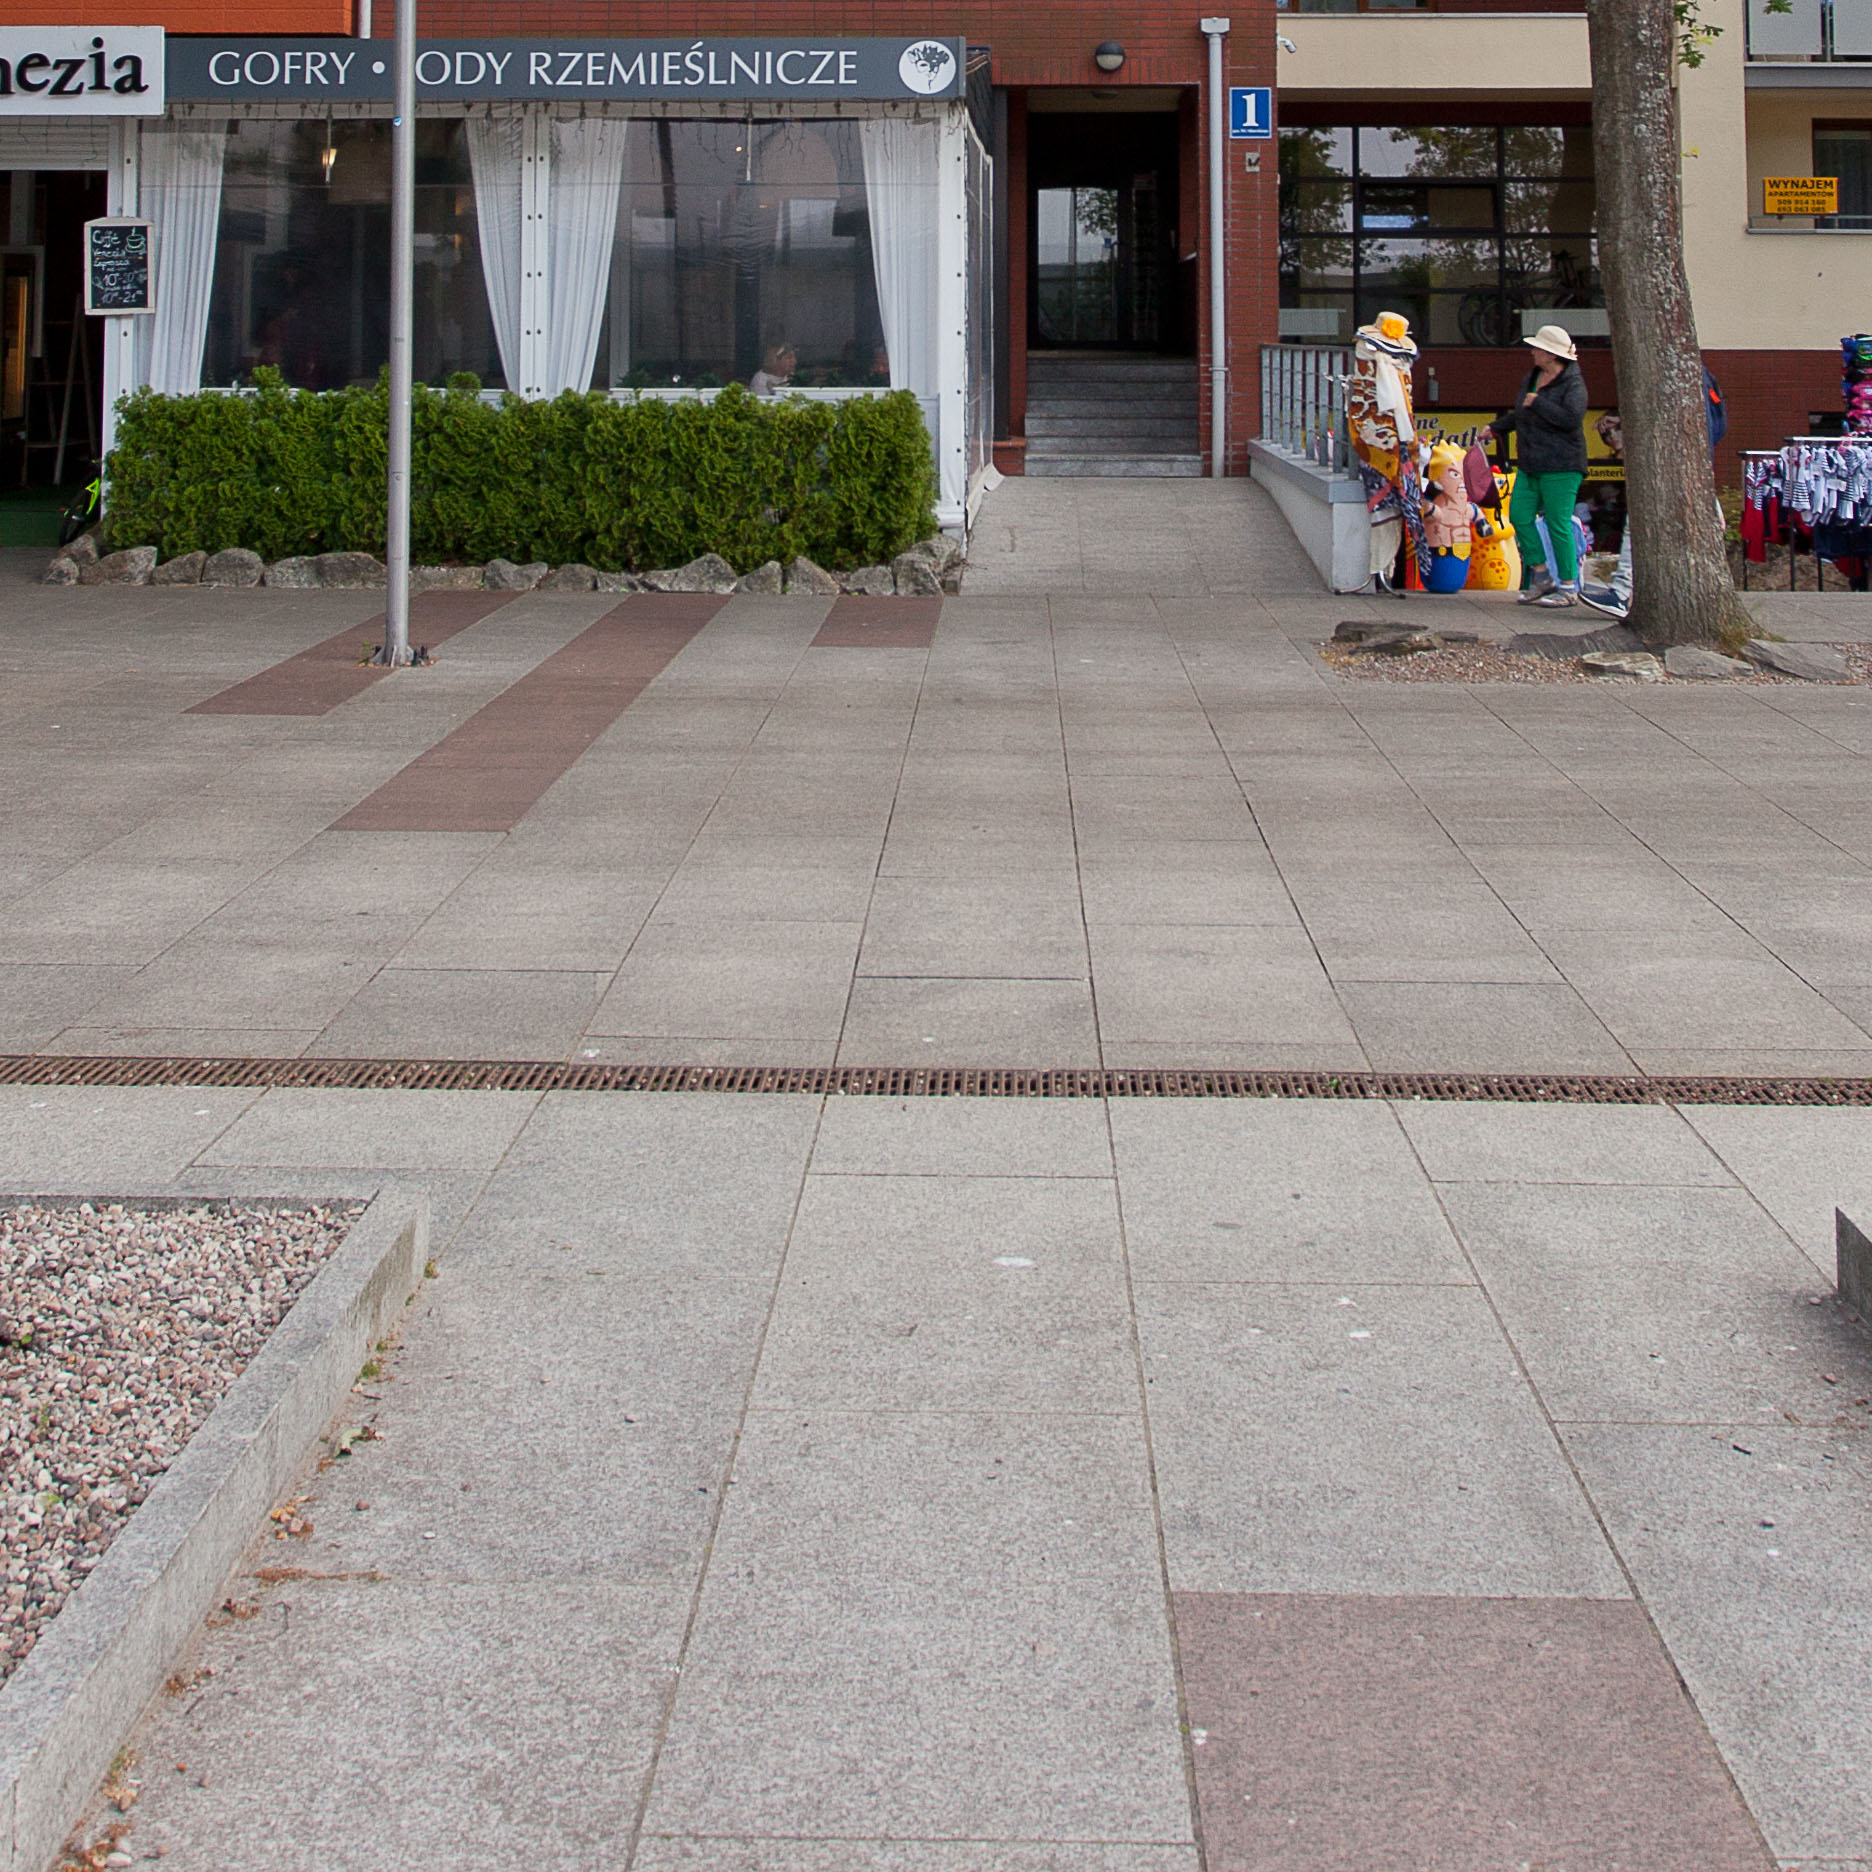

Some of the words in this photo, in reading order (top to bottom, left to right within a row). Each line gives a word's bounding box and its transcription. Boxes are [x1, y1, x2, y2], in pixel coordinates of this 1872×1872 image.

[208, 51, 356, 85] GOFRY
[414, 51, 512, 85] ODY
[528, 41, 858, 86] RZEMIEŚLNICZE
[1241, 92, 1260, 127] 1
[1768, 179, 1834, 189] WYNAJEM
